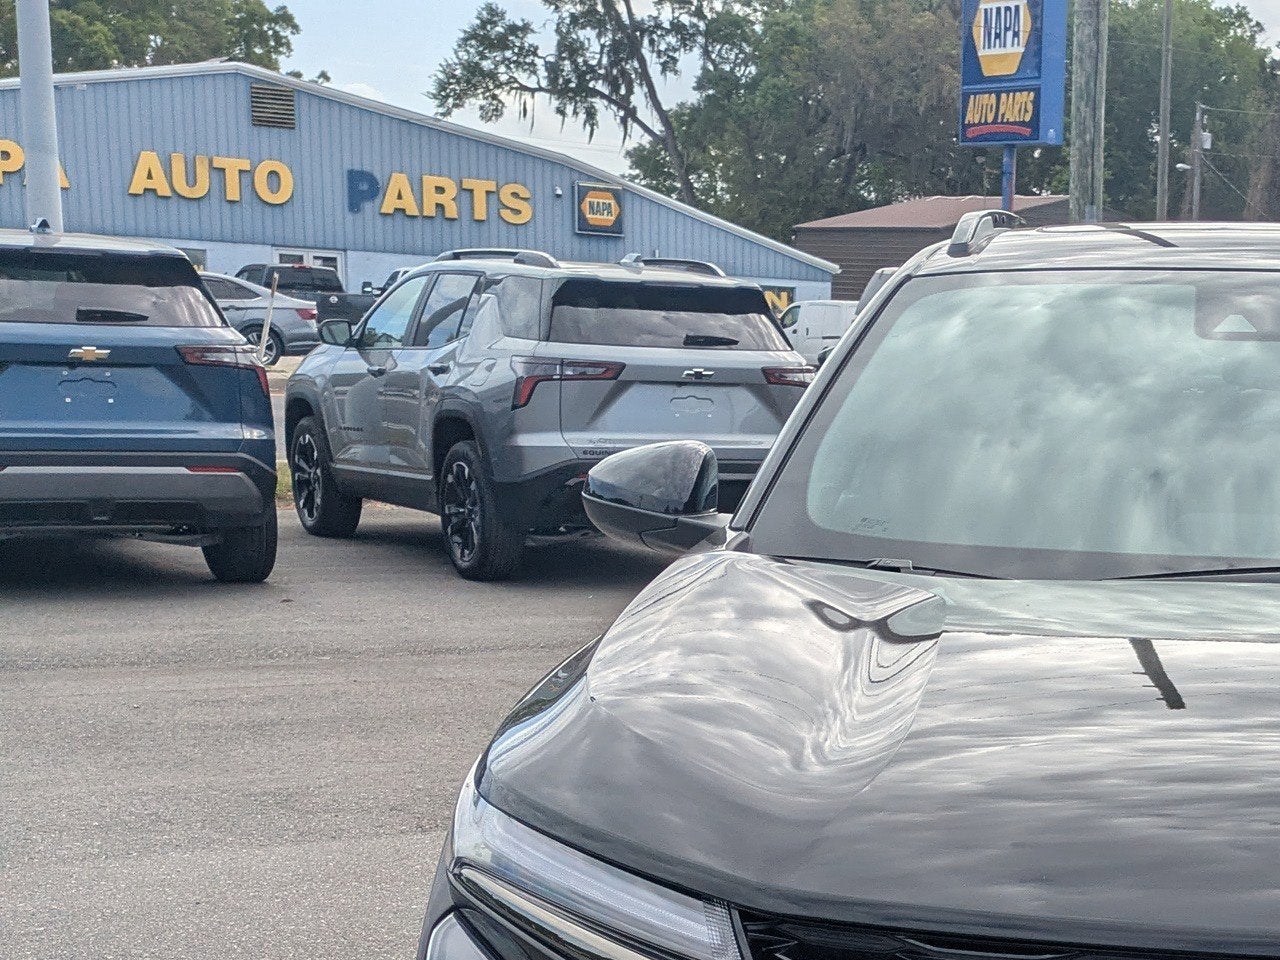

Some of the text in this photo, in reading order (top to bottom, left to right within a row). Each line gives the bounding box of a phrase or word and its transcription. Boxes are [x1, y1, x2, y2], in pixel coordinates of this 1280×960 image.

[982, 5, 1020, 50] NAPA
[965, 91, 1035, 124] AUTO PARTS
[128, 150, 294, 205] AUTO
[347, 168, 533, 225] PARTS
[588, 200, 613, 217] NAPA
